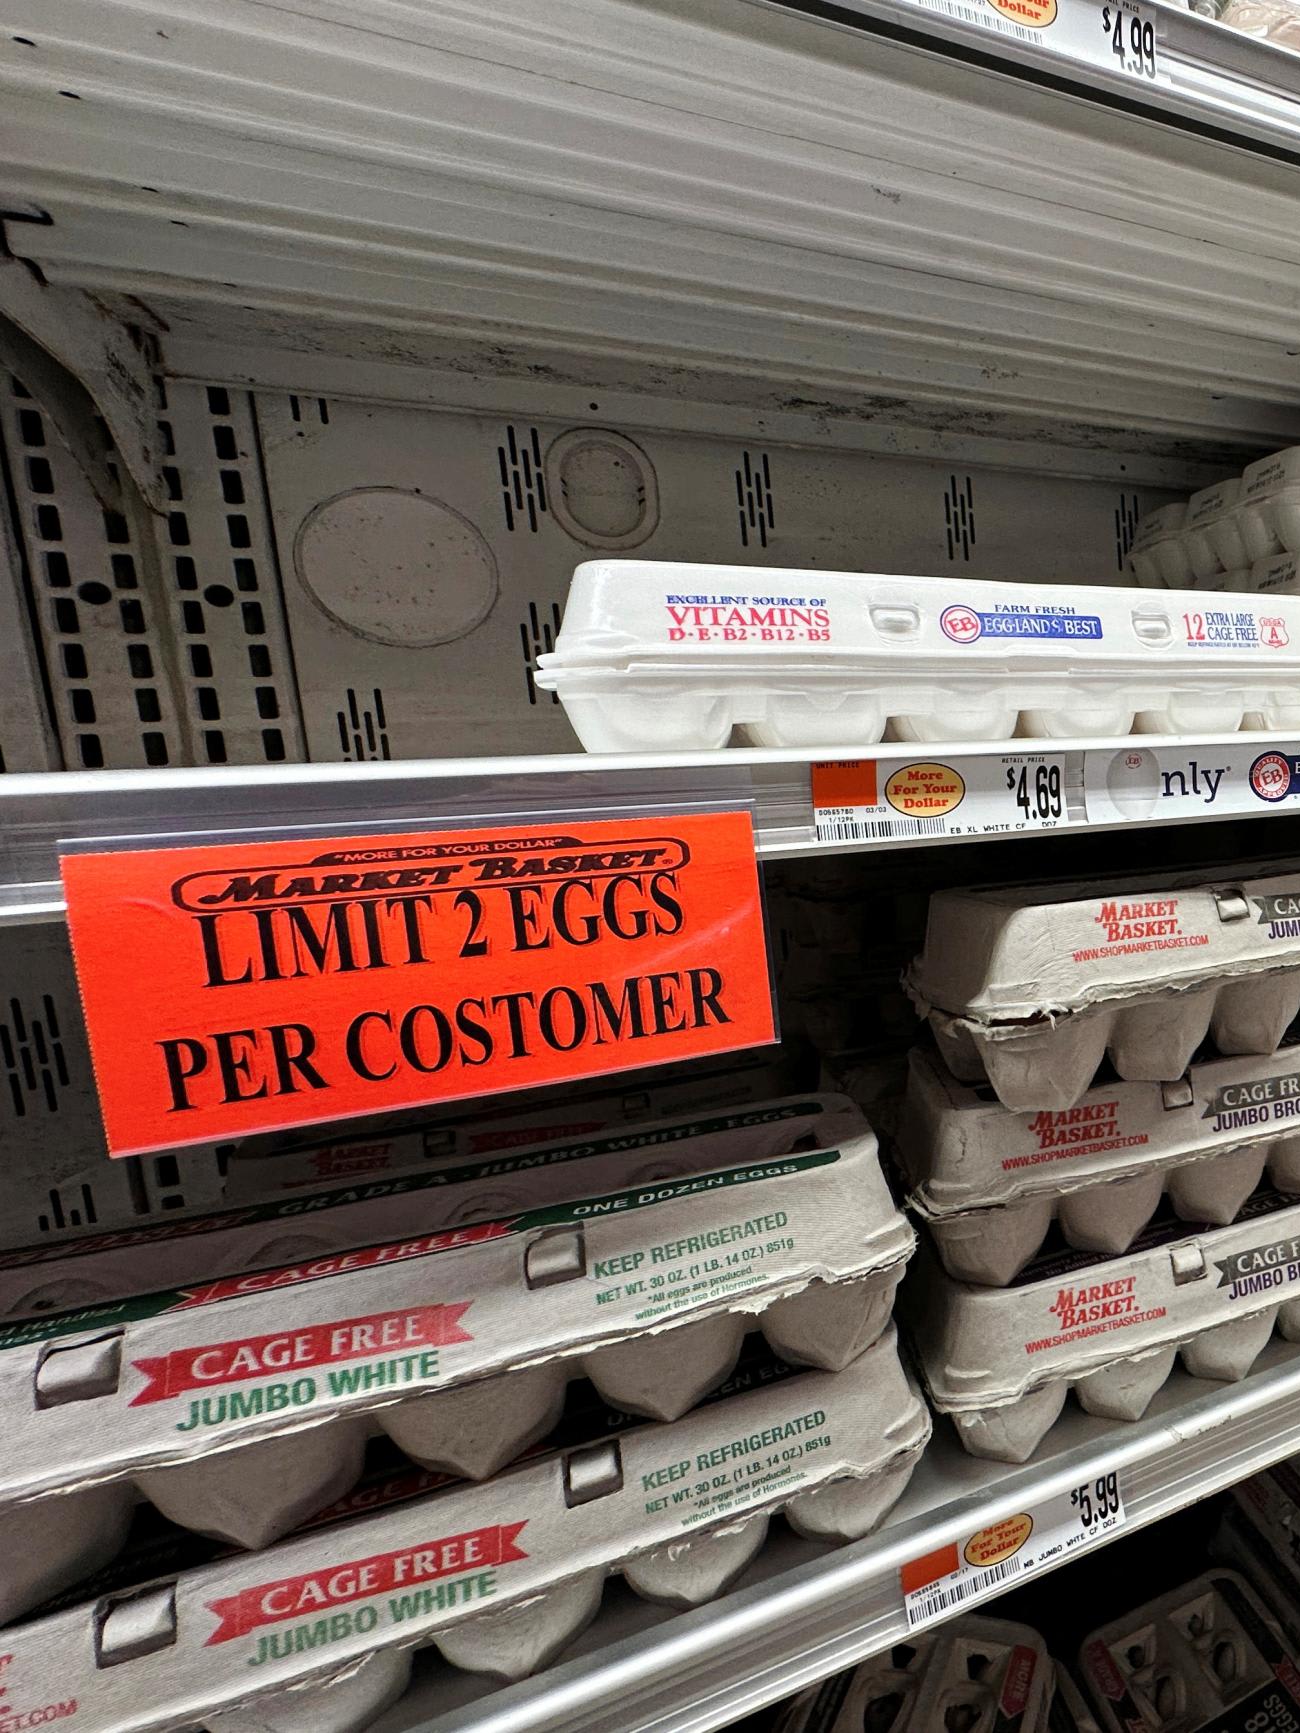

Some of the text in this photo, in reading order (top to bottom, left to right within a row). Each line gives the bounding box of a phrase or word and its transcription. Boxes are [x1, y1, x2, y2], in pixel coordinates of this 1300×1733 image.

[1103, 7, 1156, 79] $4.99
[667, 595, 826, 606] EXCELLENT SOURCE OF
[995, 604, 1075, 615] FARM FRESH
[665, 606, 830, 627] VITAMINS
[1065, 619, 1098, 635] BEST
[1182, 613, 1205, 640] 12
[1205, 612, 1255, 627] EXTRA LARGE
[1208, 627, 1258, 641] CAGE FREE
[891, 783, 957, 796] For Your
[907, 770, 943, 781] More
[1261, 769, 1283, 786] EB
[903, 798, 949, 809] Dollar
[1007, 765, 1062, 820] $4.69
[984, 824, 1010, 832] WHITE
[402, 845, 433, 859] FOR
[437, 841, 489, 857] YOUR
[199, 865, 462, 904] MARKET
[1095, 900, 1178, 922] MARKET
[193, 873, 686, 988] LIMIT 2 EGGS
[157, 967, 732, 1112] PER COSTOMER
[1223, 1080, 1275, 1107] CAGE
[1028, 1100, 1119, 1130] MARKET
[1212, 1102, 1269, 1132] JUMBO
[278, 1178, 418, 1217] GRADE
[477, 1146, 594, 1178] JUMBO
[607, 1125, 701, 1152] WHITE
[727, 1107, 799, 1130] EGGS
[236, 1163, 799, 1292] CAGE FREE ONE DOZEN EGGS
[594, 1209, 789, 1280] KEEP REFRIGERATED
[1237, 1245, 1288, 1273] CAGE
[1050, 1277, 1137, 1314] MARKET
[1229, 1268, 1283, 1300] JUMBO
[1025, 1308, 1167, 1353] WWW.SHOPMARKETBASKET.COM
[191, 1313, 428, 1380] CAGE FREE
[176, 1349, 440, 1432] JUMBO WHITE
[641, 1409, 826, 1492] KEEP REFRIGERATED
[645, 1498, 669, 1515] NET
[671, 1488, 694, 1508] WT.
[695, 1482, 710, 1497] 30
[712, 1474, 731, 1491] OZ.
[746, 1462, 763, 1478] LB.
[767, 1455, 780, 1470] 14
[806, 1434, 832, 1453] 851g
[1071, 1472, 1119, 1527] $5.99
[971, 1522, 1026, 1553] For Your
[981, 1536, 1020, 1561] Dollar
[1039, 1545, 1063, 1562] JUMBO
[1090, 1526, 1098, 1537] CF
[261, 1536, 482, 1616] CAGE FREE
[248, 1570, 496, 1667] JUMBO WHITE
